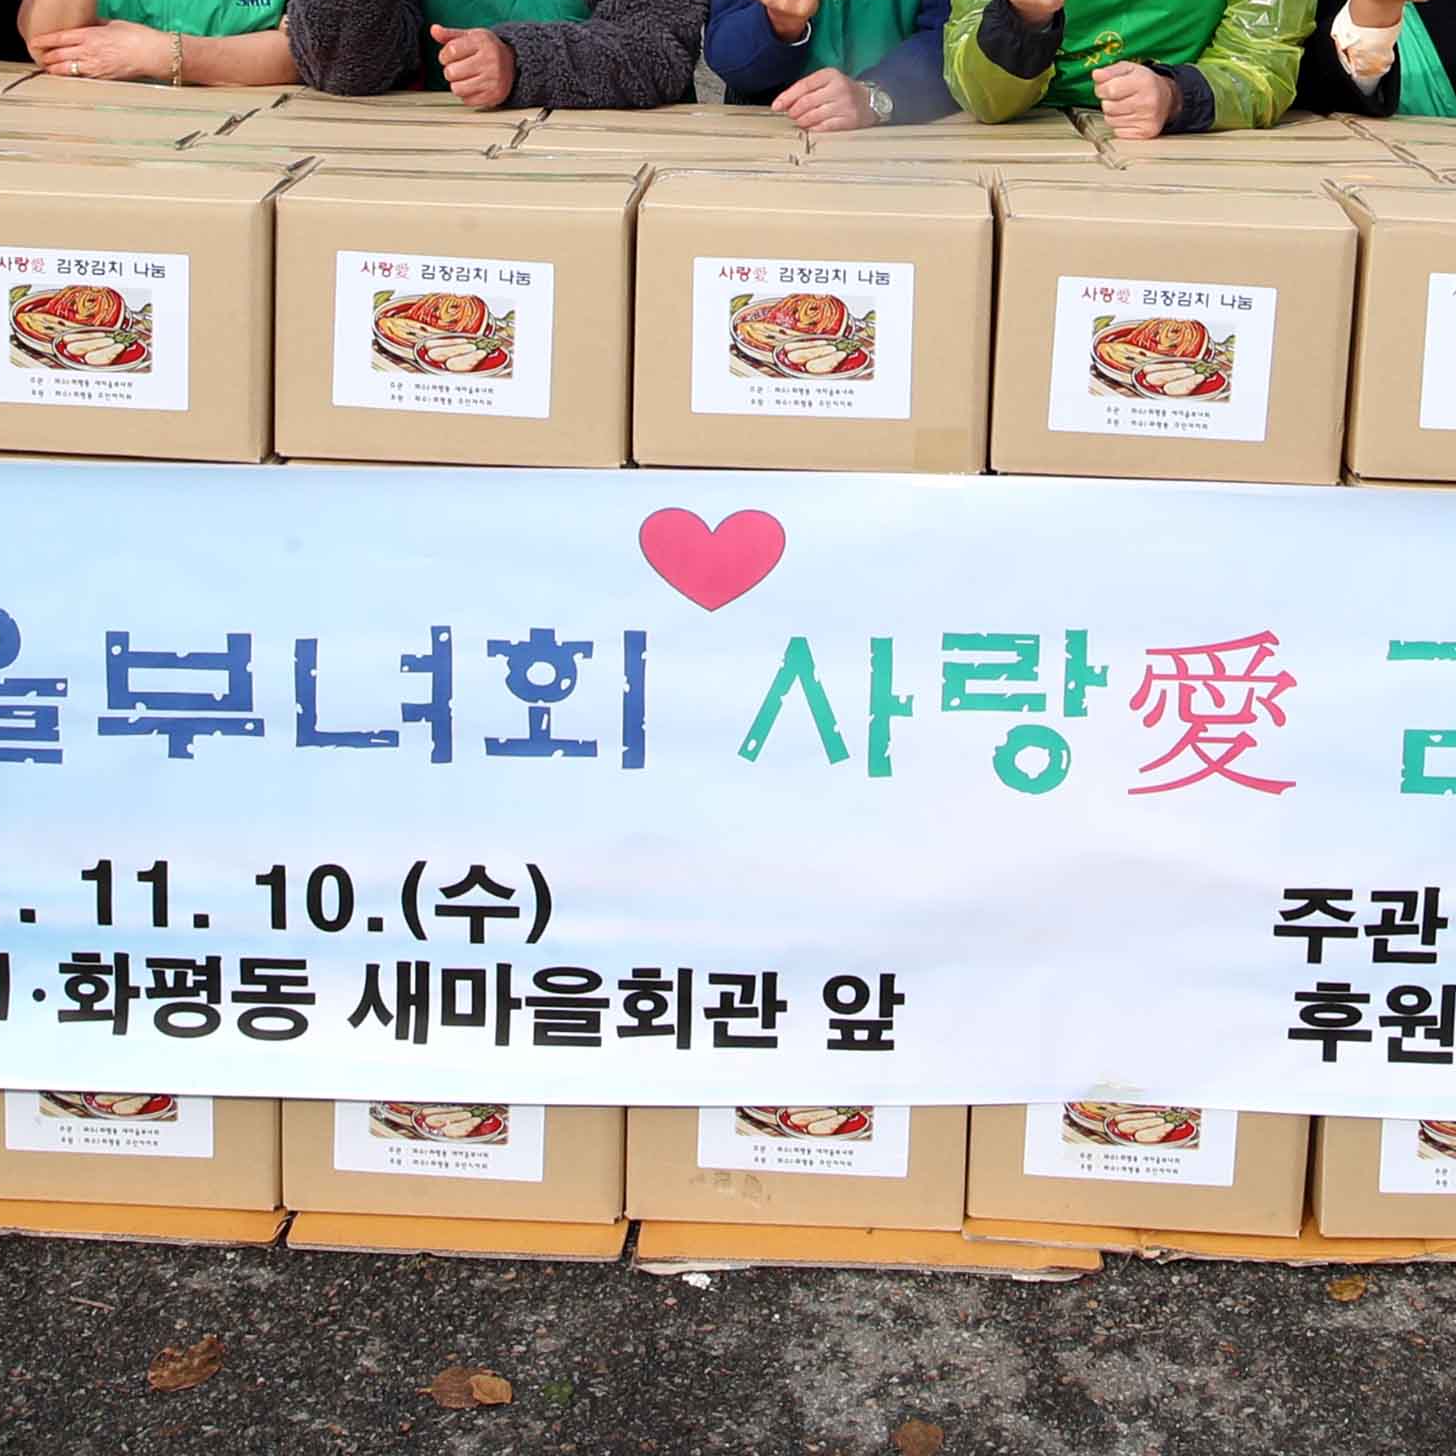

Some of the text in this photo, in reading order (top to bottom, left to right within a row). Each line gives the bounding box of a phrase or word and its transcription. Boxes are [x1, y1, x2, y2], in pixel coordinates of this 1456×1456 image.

[57, 259, 123, 277] 김장김치
[134, 262, 165, 278] 나눔
[421, 264, 487, 283] 김장김치
[499, 270, 531, 286] 나눔
[780, 268, 846, 285] 김장김치
[858, 270, 890, 286] 나눔
[1143, 289, 1210, 308] 김장김치
[1221, 294, 1253, 310] 나눔
[737, 629, 1298, 797] 사랑愛
[81, 859, 209, 930] 11.
[1272, 888, 1448, 966] 주관
[348, 958, 787, 1051] 새마을회관
[821, 974, 905, 1051] 앞
[1288, 981, 1456, 1065] 후원
